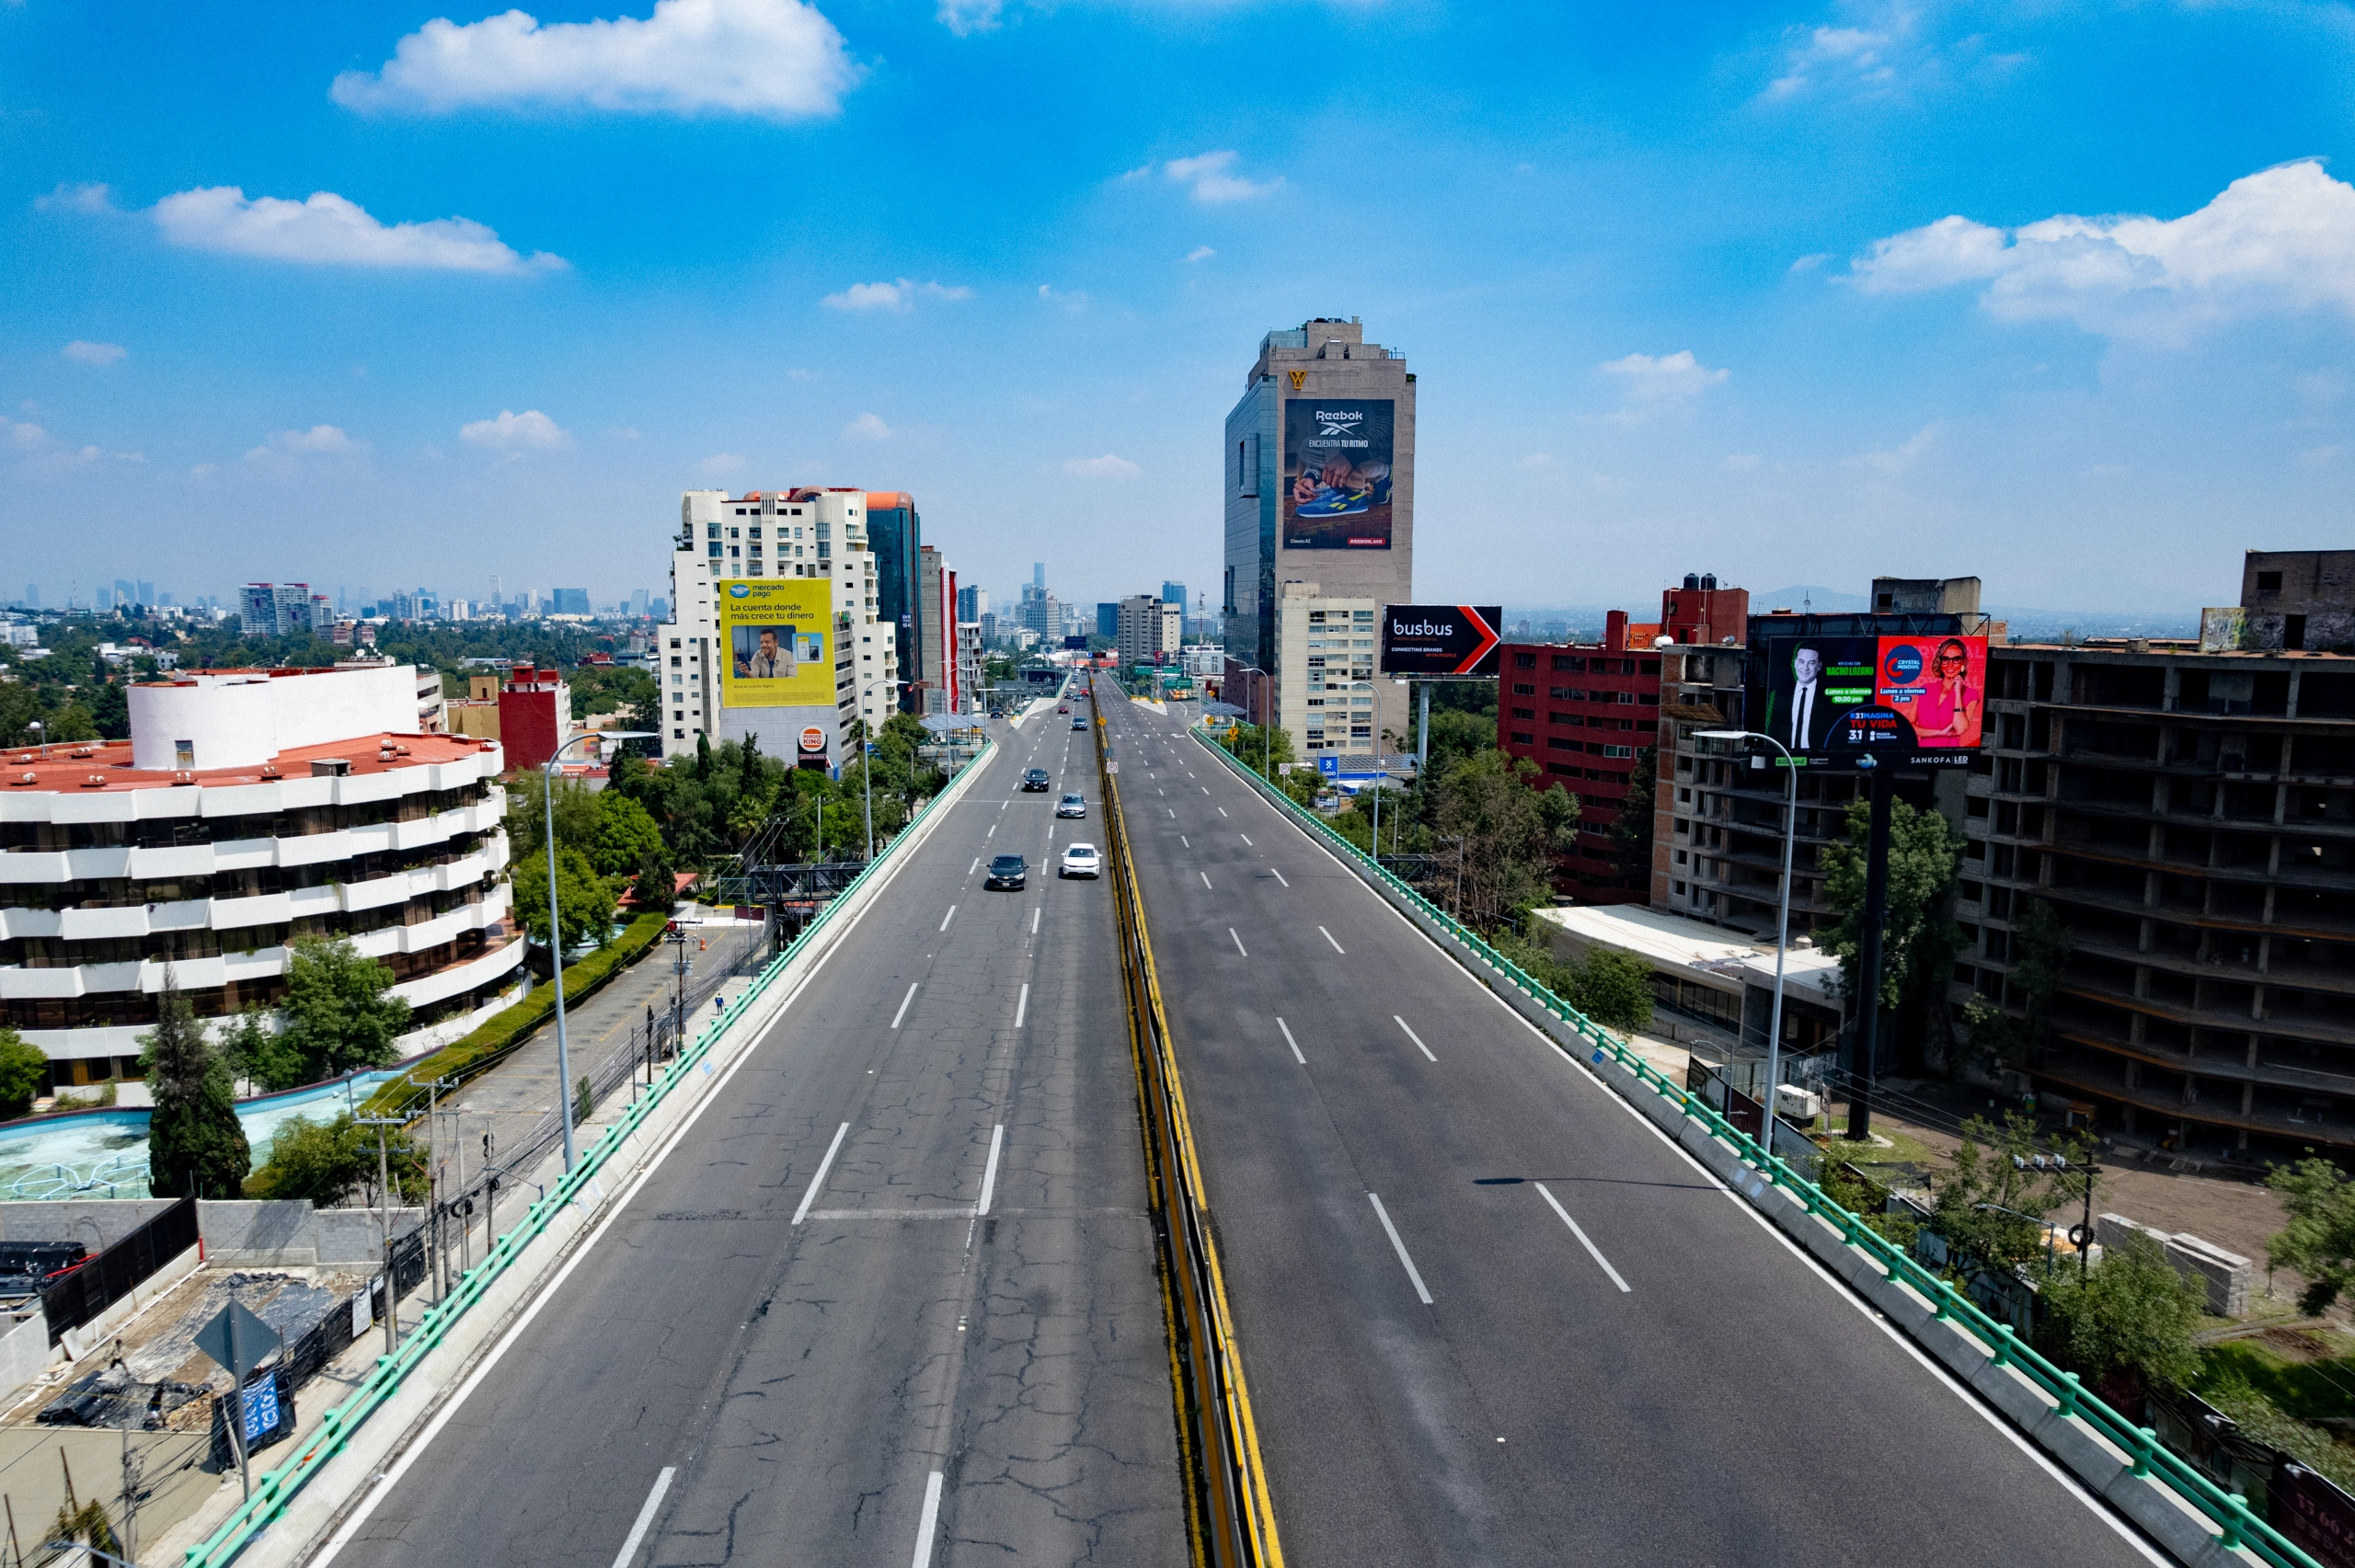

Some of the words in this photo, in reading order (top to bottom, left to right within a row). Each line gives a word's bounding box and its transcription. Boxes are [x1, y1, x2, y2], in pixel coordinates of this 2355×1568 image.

[1315, 410, 1363, 422] Reebok
[1309, 439, 1340, 448] ENCUENTRA
[1340, 439, 1349, 448] TU
[1350, 439, 1369, 448] RITMO
[730, 603, 741, 612] La
[730, 612, 749, 620] más
[1394, 619, 1453, 635] busbus
[1826, 666, 1849, 677] NACHO
[1849, 666, 1874, 676] LOZANO
[1850, 719, 1866, 728] TU
[1869, 719, 1898, 728] VIDA
[1848, 729, 1863, 740] 3.1
